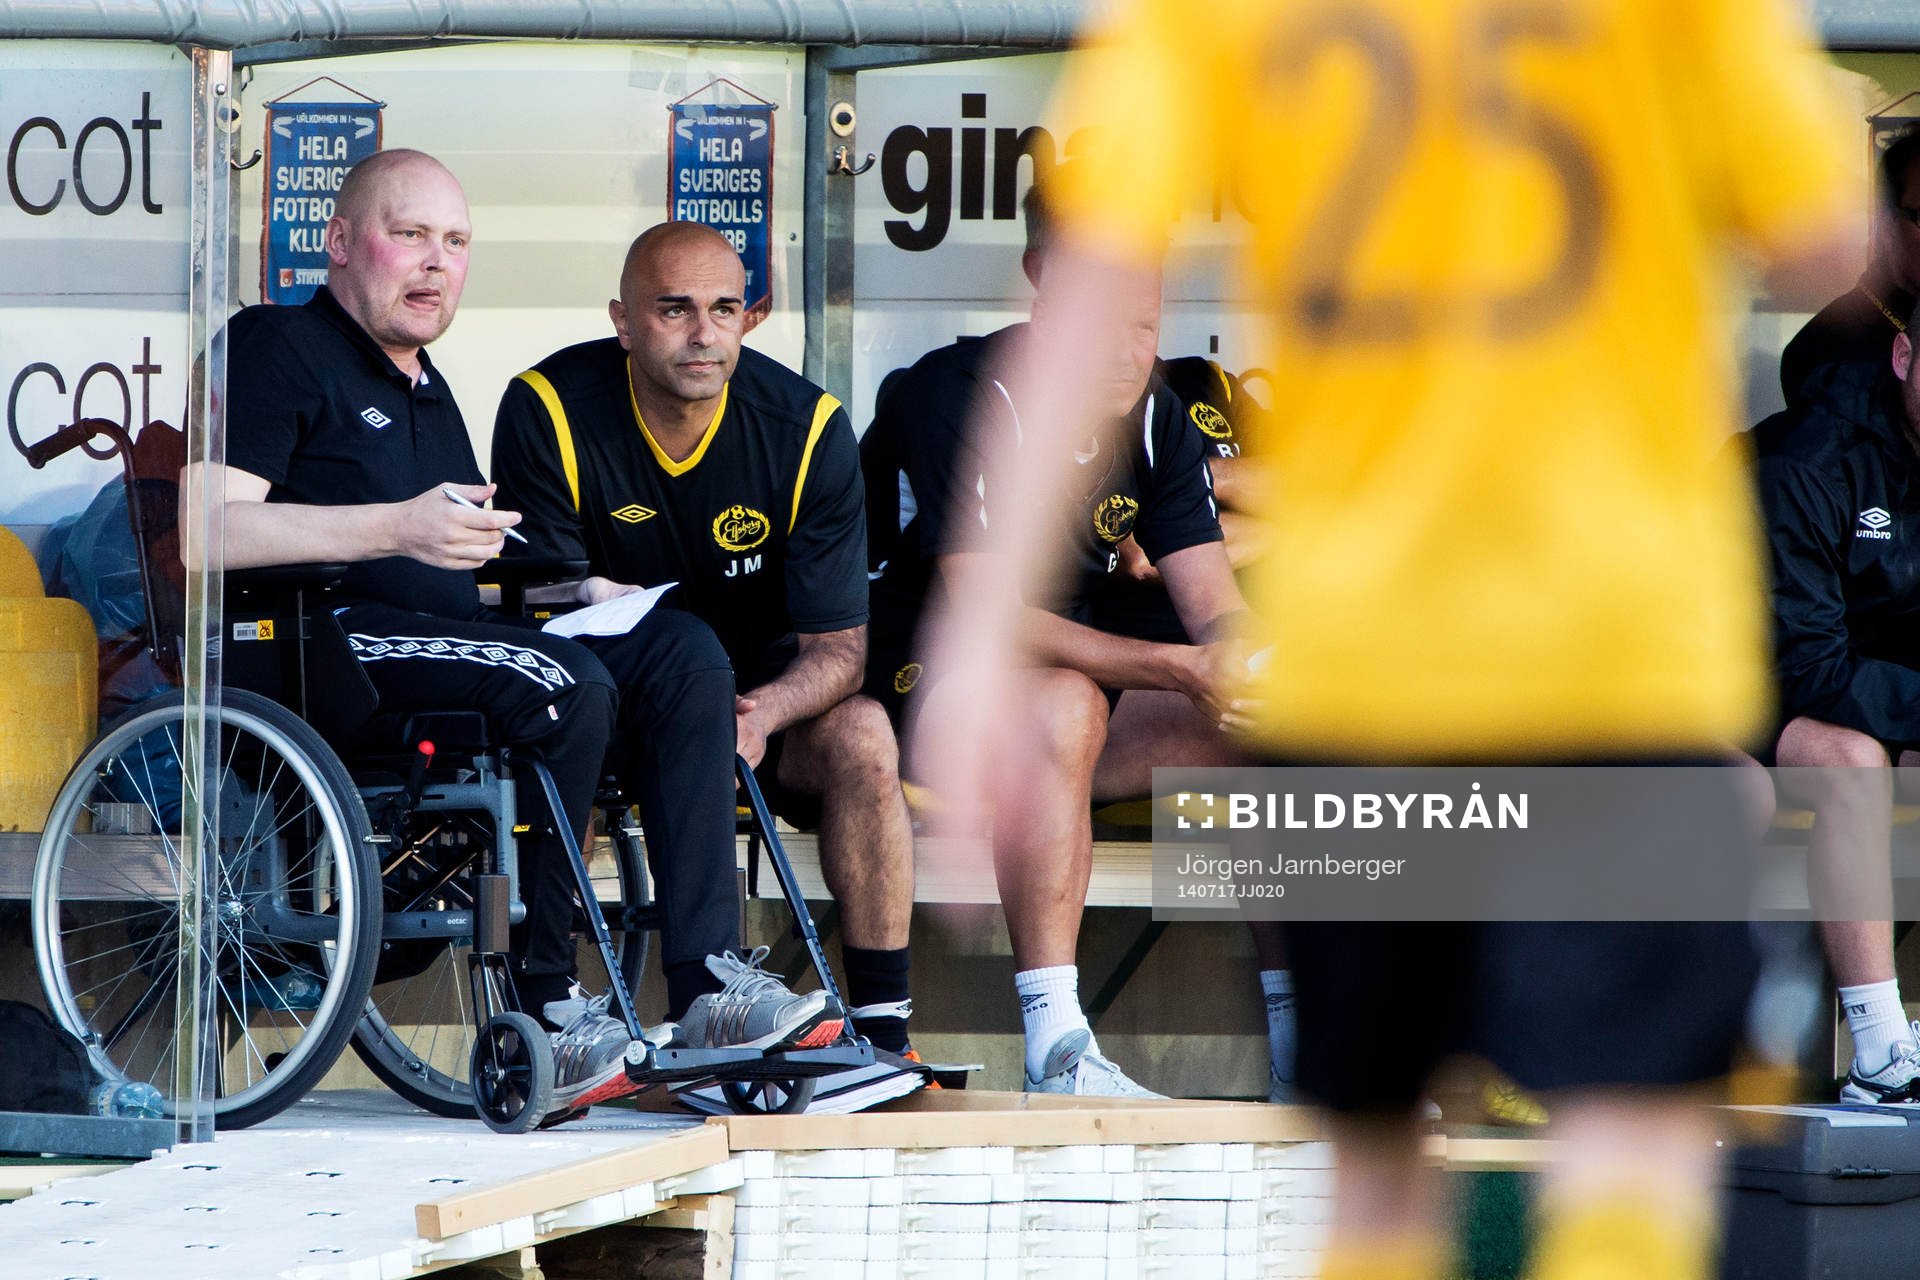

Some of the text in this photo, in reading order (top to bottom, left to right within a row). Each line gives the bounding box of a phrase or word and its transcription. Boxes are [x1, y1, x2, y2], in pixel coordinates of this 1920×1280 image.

[7, 91, 163, 215] cot
[298, 135, 348, 161] HELA
[699, 138, 743, 162] HELA
[276, 166, 352, 191] SVERIG
[679, 168, 762, 193] SVERIGES
[273, 197, 336, 222] FOTBO
[676, 199, 763, 223] FOTBOLLS
[289, 228, 327, 253] KLU
[295, 271, 328, 286] STRYK
[1856, 528, 1892, 540] umbro
